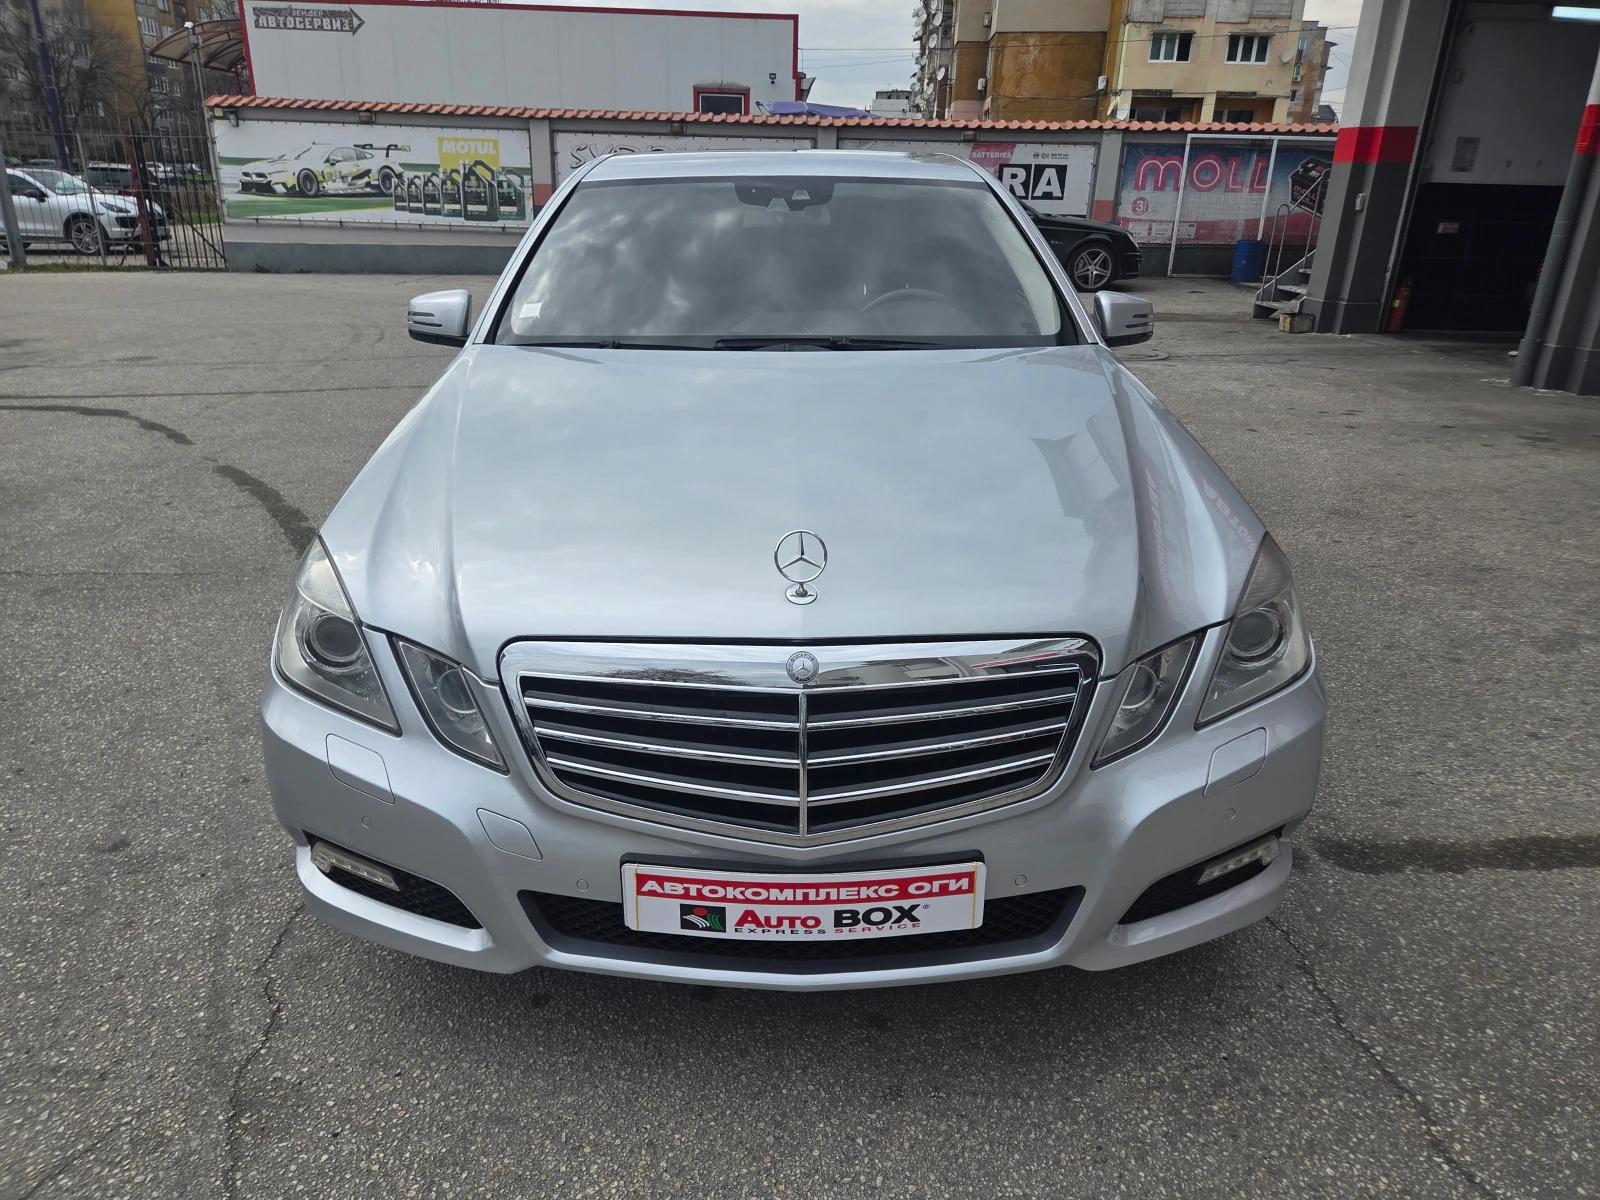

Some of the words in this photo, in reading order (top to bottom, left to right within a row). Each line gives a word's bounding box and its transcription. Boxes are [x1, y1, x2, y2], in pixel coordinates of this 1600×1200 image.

[258, 15, 350, 31] АВТОСЕРВИЗ
[441, 140, 497, 155] MOTUL
[971, 151, 1012, 159] BATTERIES
[640, 880, 900, 901] АВТОКОМПЛЕКС
[907, 877, 970, 894] ОГИ
[734, 927, 827, 935] EXPRESS
[834, 922, 921, 934] SERVICE
